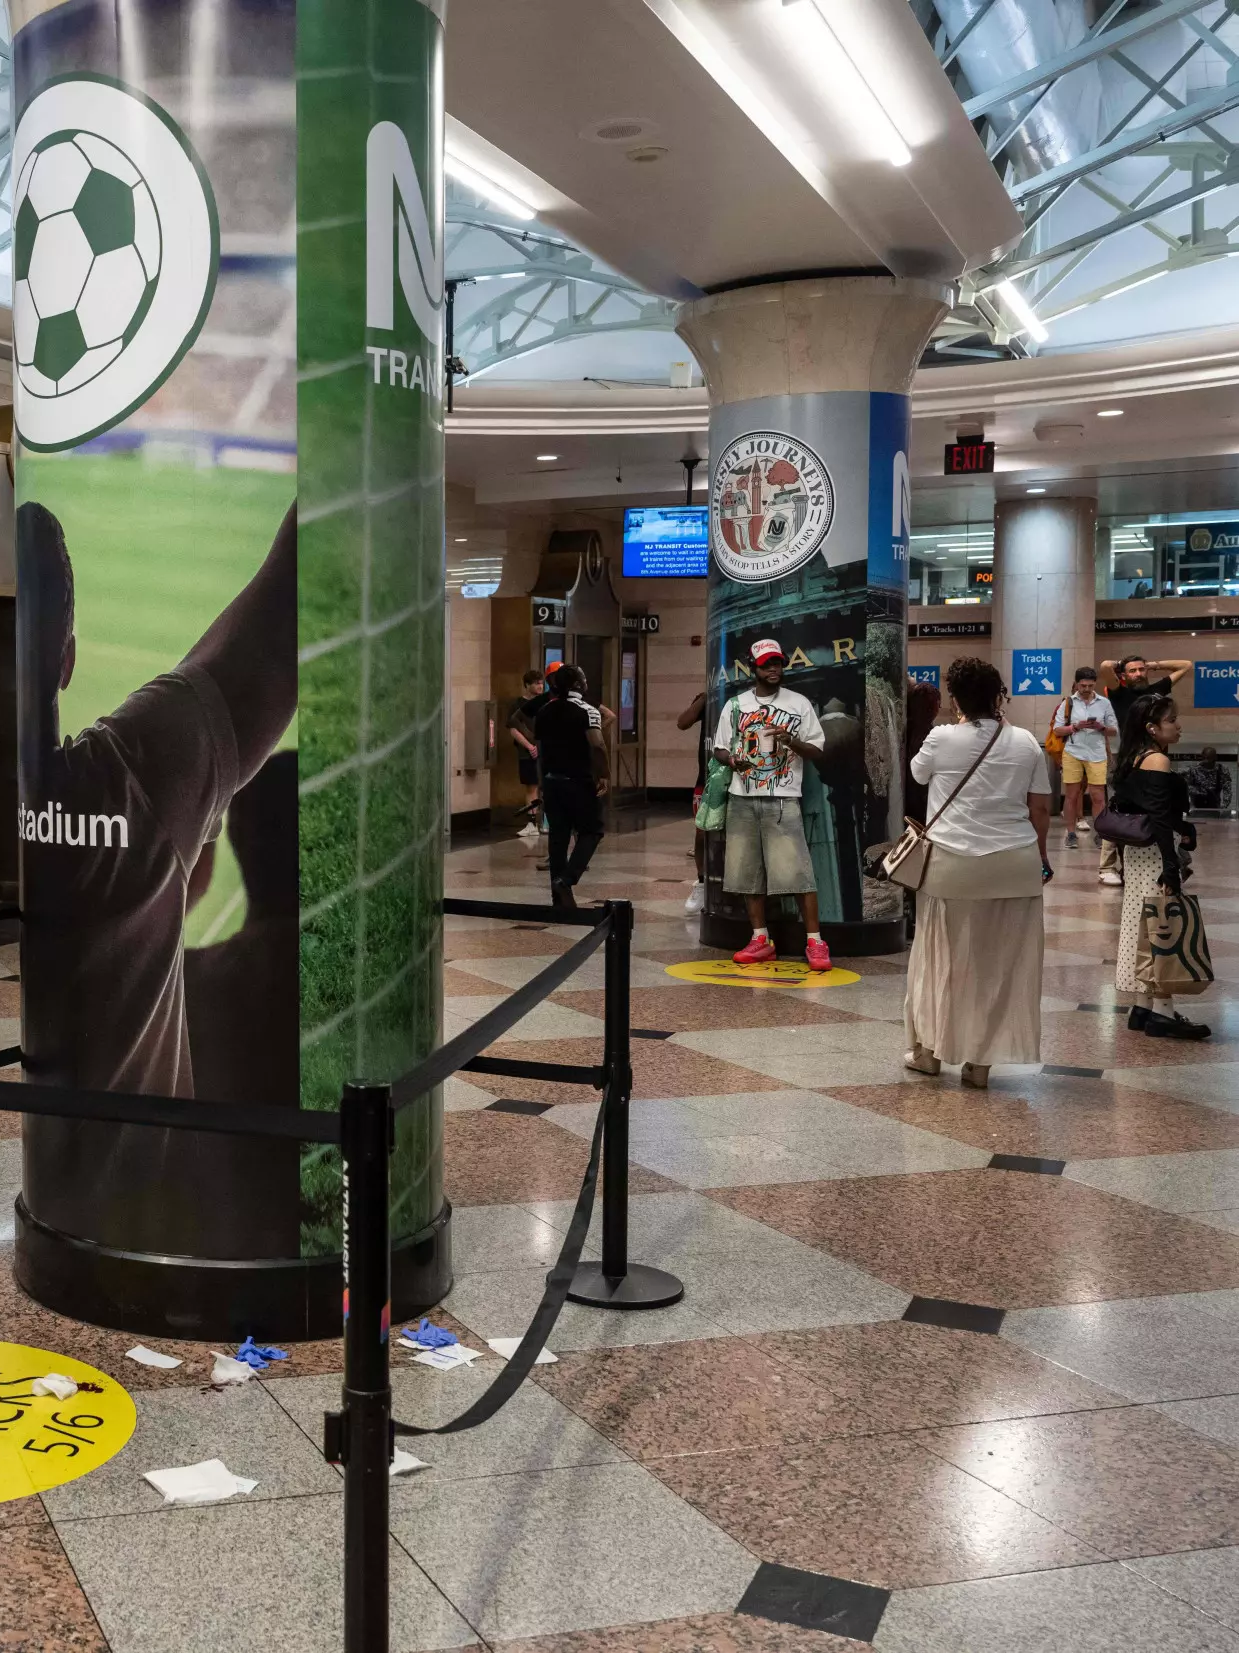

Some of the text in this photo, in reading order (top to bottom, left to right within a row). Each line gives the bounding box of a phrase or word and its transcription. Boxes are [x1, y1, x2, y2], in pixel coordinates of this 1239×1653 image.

[952, 445, 986, 471] EXIT
[713, 439, 825, 517] JERSEY JOURNEYS
[730, 557, 749, 570] STOP
[750, 558, 780, 571] TELLS
[782, 552, 790, 562] A
[790, 528, 815, 557] STORY
[538, 606, 550, 622] 9
[640, 617, 658, 630] 10
[932, 625, 956, 633] Tracks
[1113, 621, 1143, 629] Subway
[1021, 653, 1052, 663] Tracks
[1025, 666, 1048, 675] 11-21
[23, 1411, 105, 1458] 5/6
